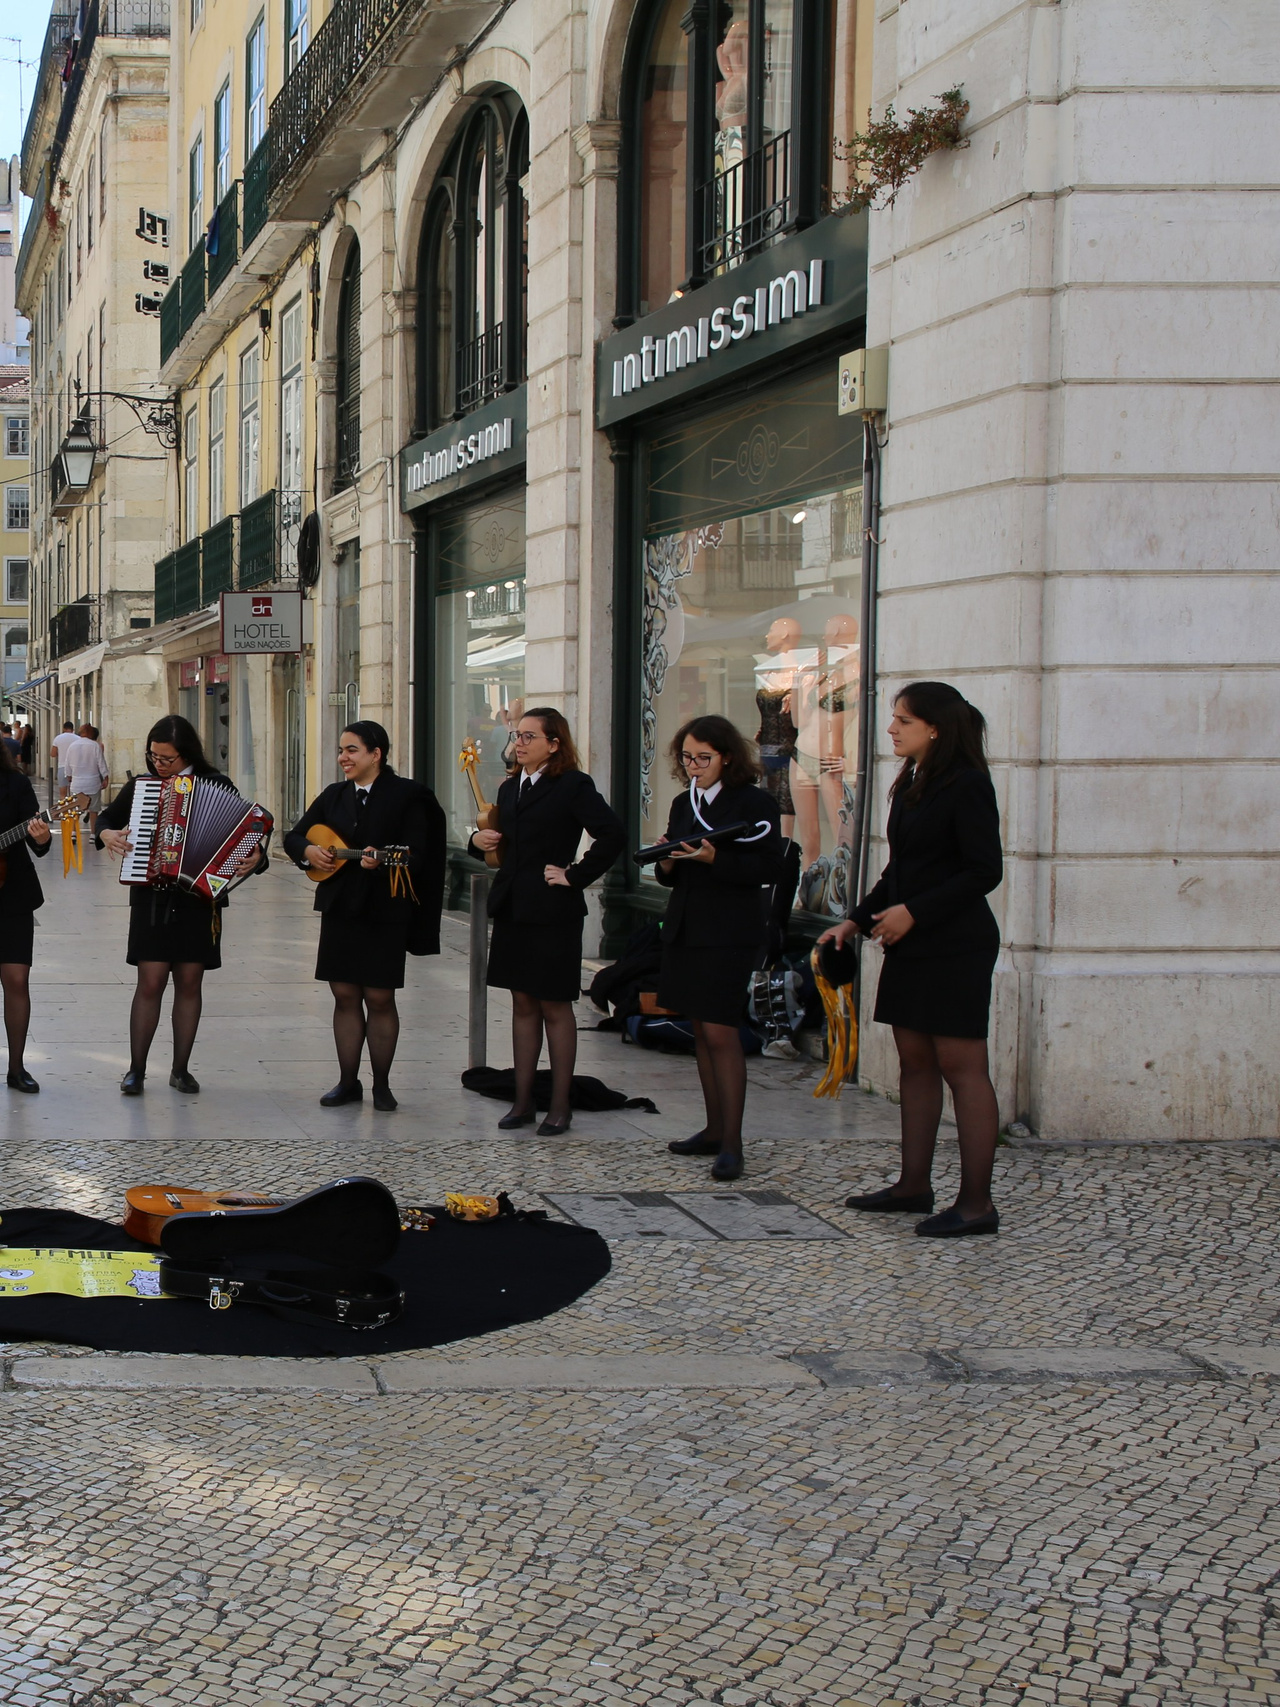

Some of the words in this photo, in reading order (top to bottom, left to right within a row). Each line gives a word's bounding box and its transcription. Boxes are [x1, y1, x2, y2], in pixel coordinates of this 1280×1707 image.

[612, 259, 824, 398] intimissimi
[407, 417, 512, 493] intimissimi
[234, 623, 290, 638] HOTEL
[234, 641, 255, 649] DUAS
[257, 639, 291, 649] NAÇÕES
